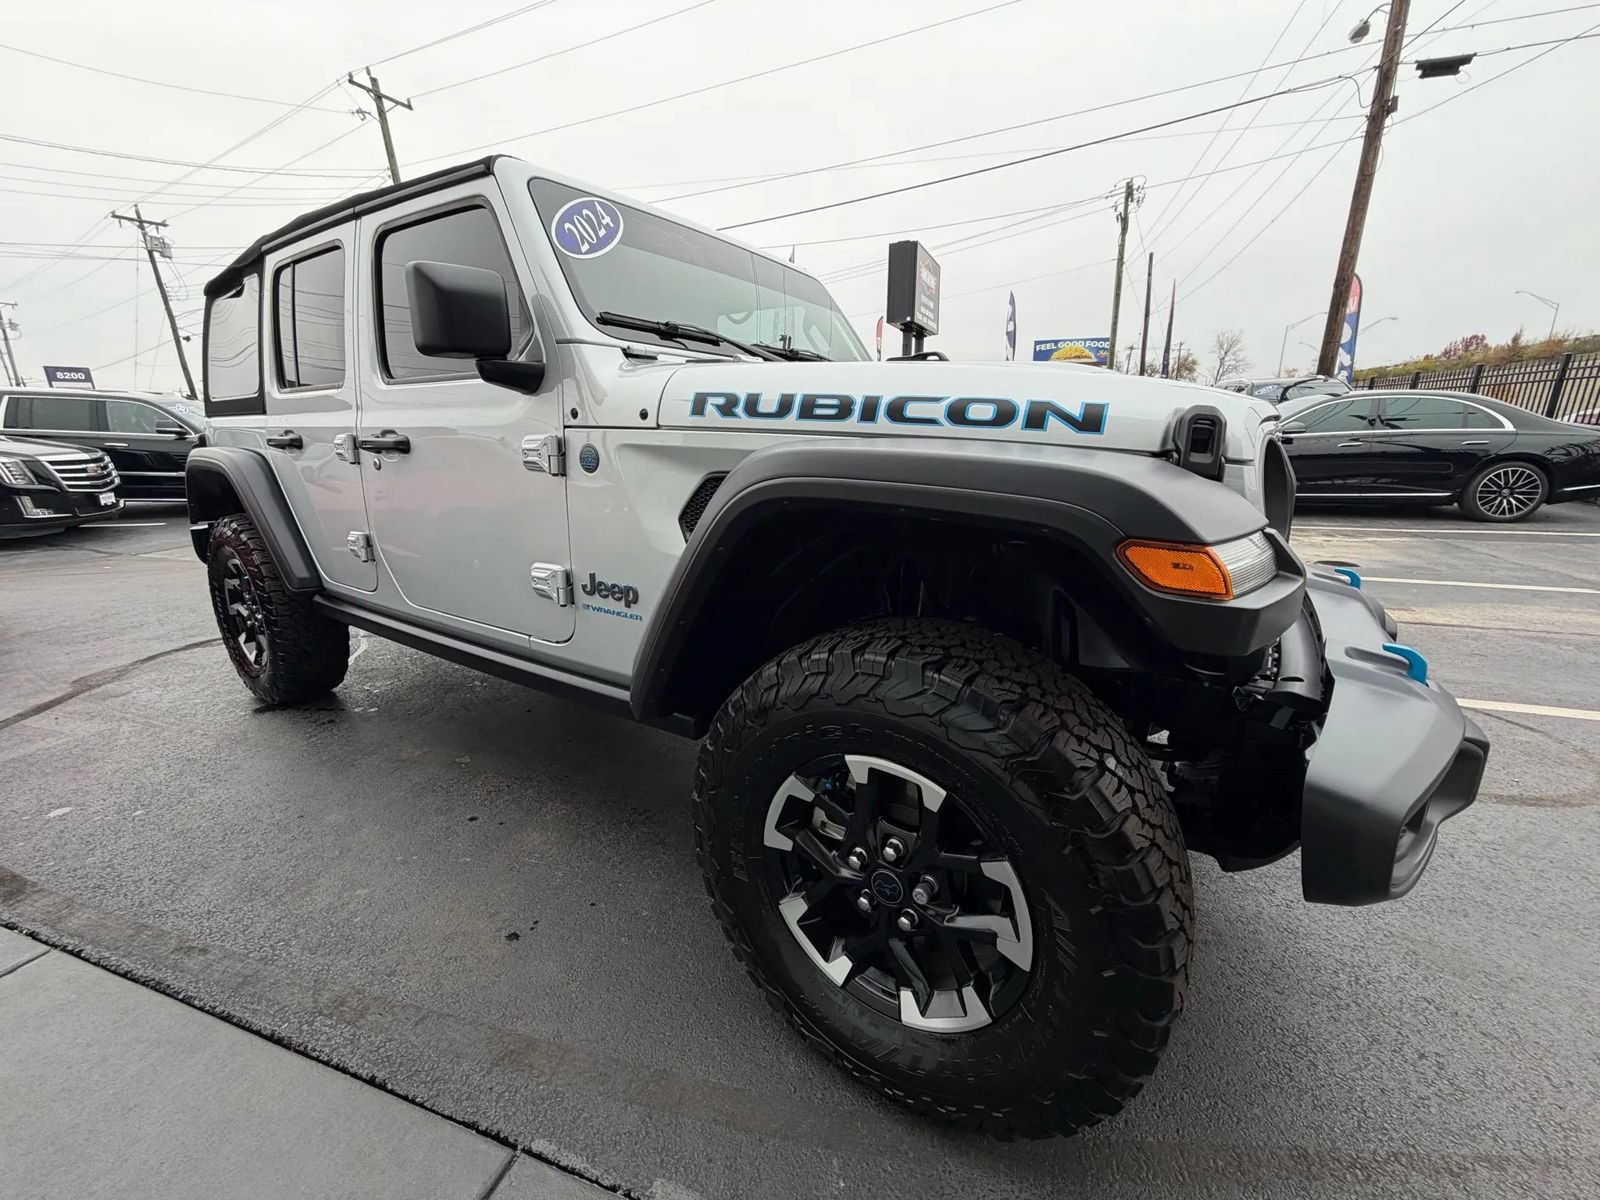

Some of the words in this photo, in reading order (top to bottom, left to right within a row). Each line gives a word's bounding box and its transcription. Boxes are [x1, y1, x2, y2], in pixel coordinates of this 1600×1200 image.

[564, 200, 614, 253] 2024
[1036, 343, 1057, 351] FEEL
[1058, 340, 1085, 348] GOOD
[56, 371, 85, 380] 8200
[688, 391, 1110, 436] RUBICON
[581, 571, 639, 609] Jeep
[590, 604, 643, 622] WRANGLER
